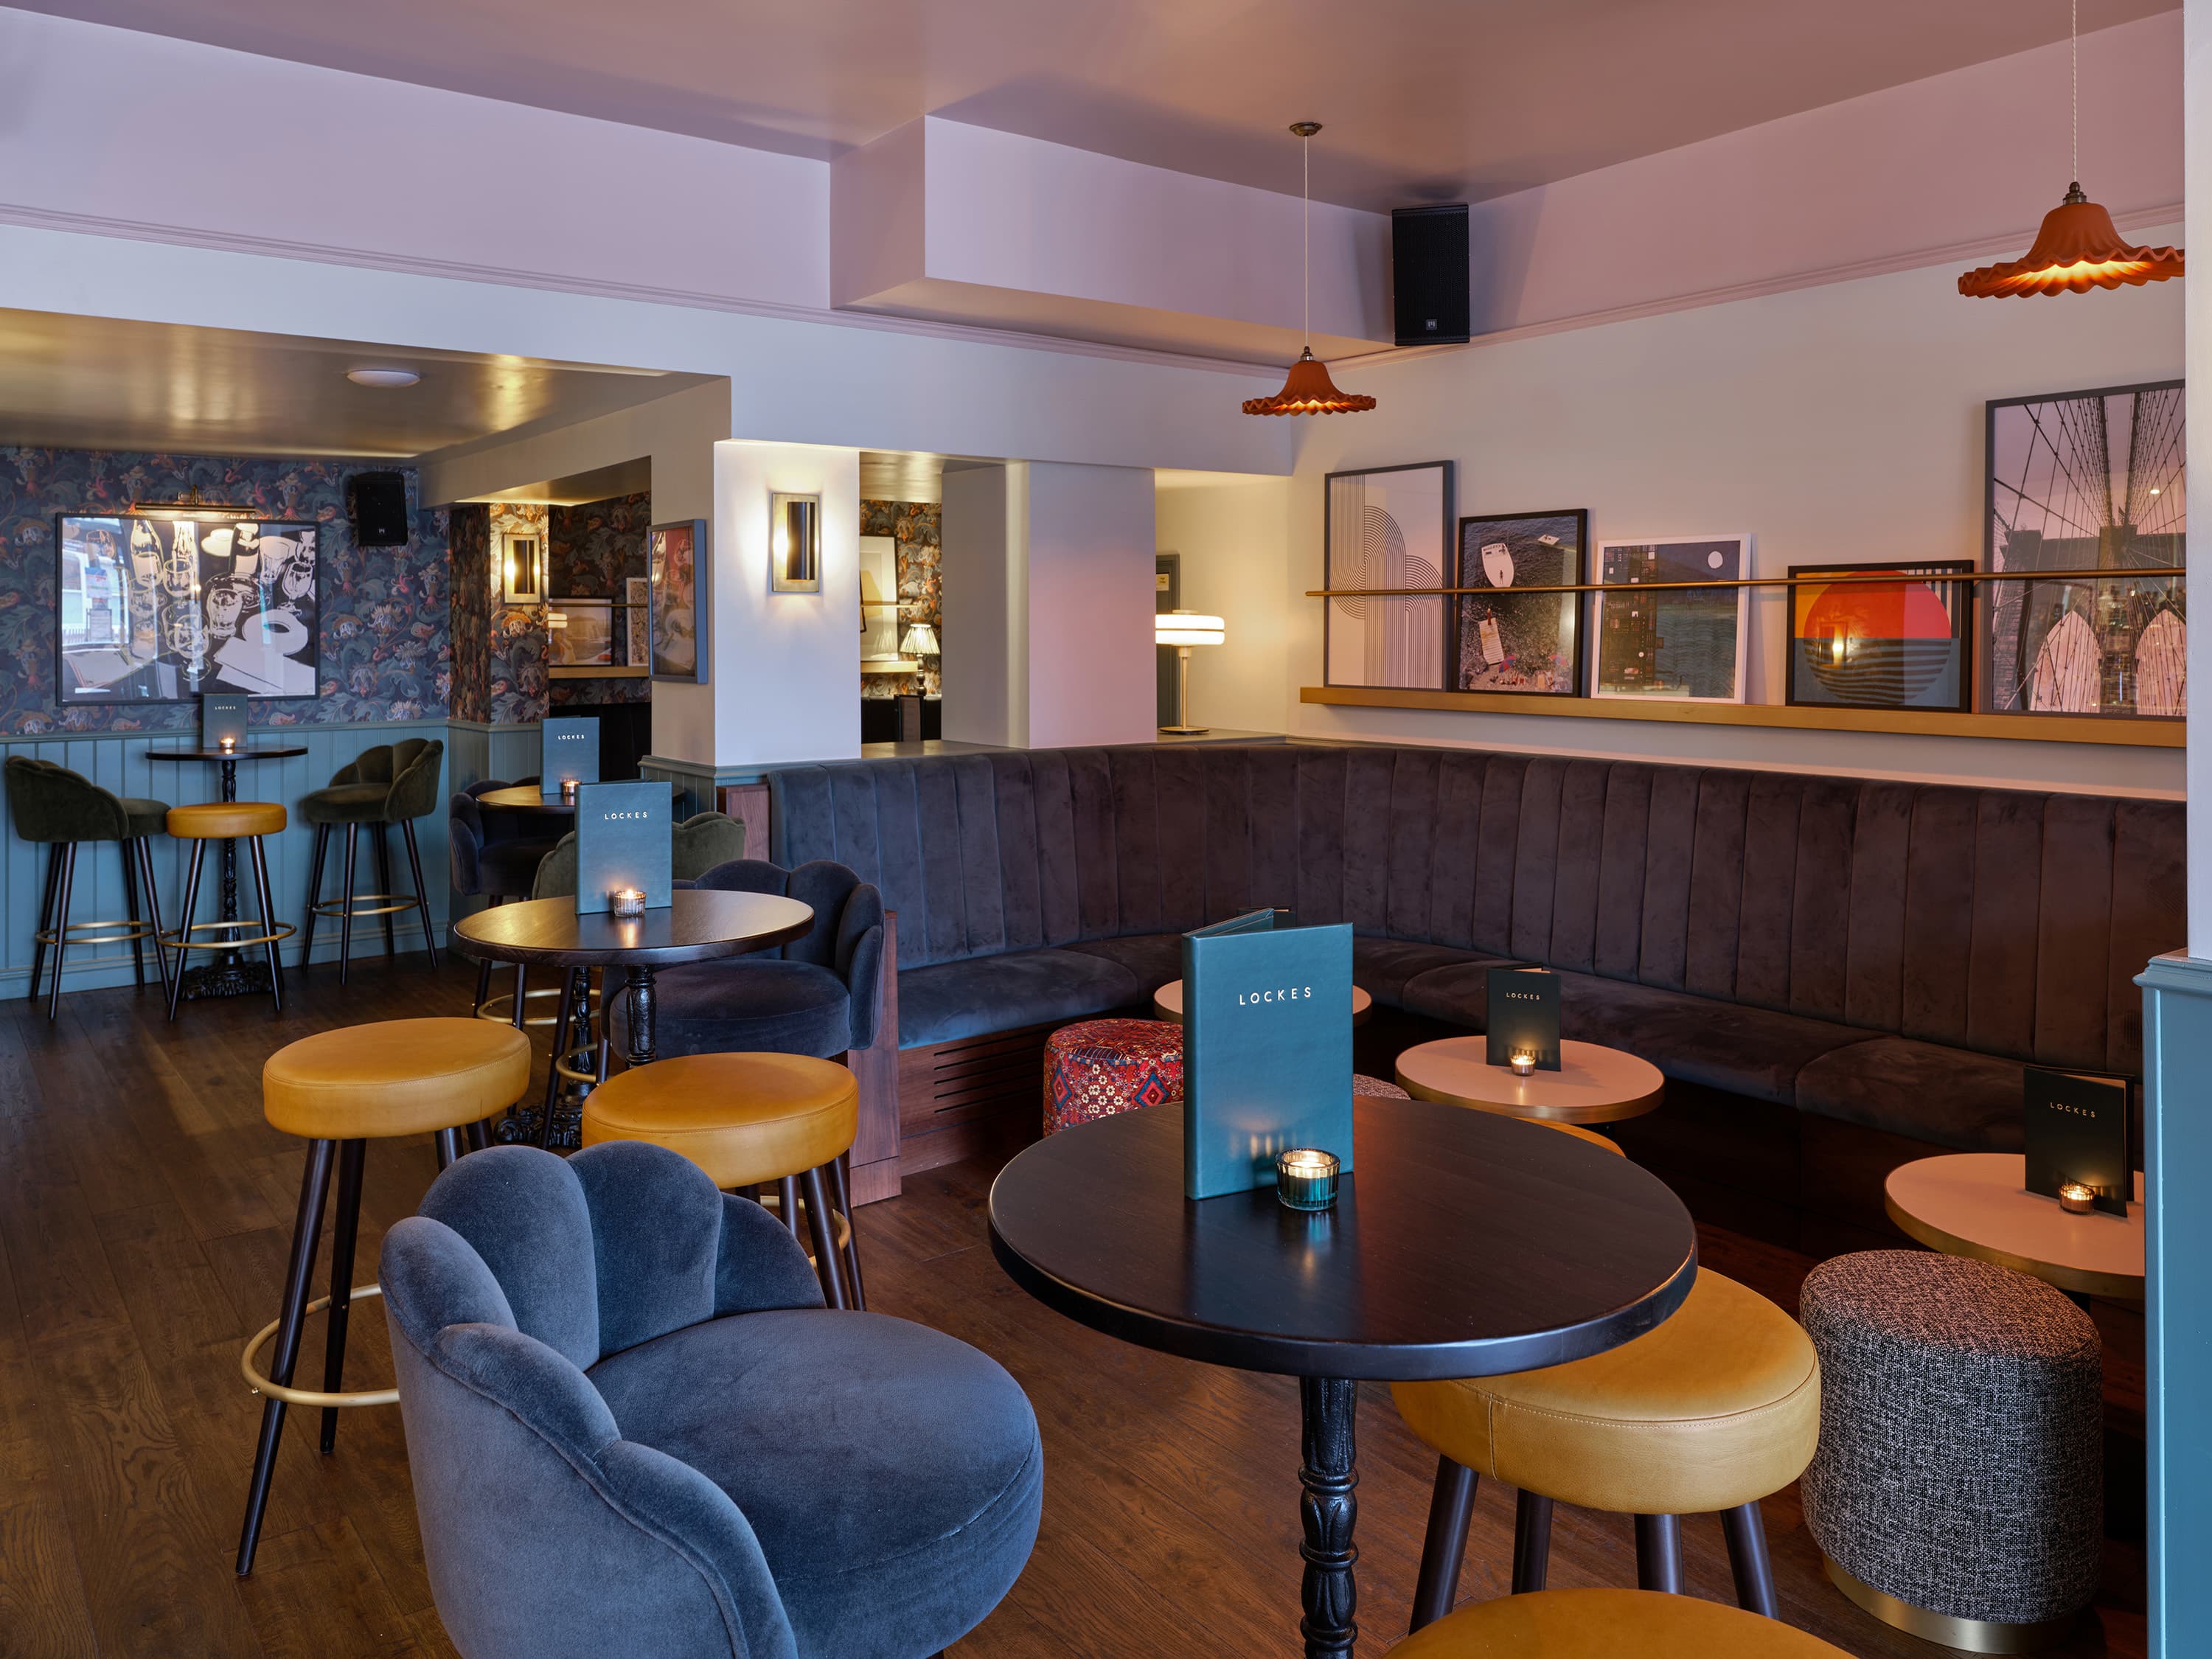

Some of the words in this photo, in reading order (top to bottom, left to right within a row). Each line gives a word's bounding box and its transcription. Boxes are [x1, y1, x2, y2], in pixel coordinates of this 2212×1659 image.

[604, 811, 648, 820] LOCKES
[1239, 987, 1311, 1006] LOCKES
[1506, 992, 1540, 1001] LOCKES
[2050, 1102, 2096, 1118] LOCKES
